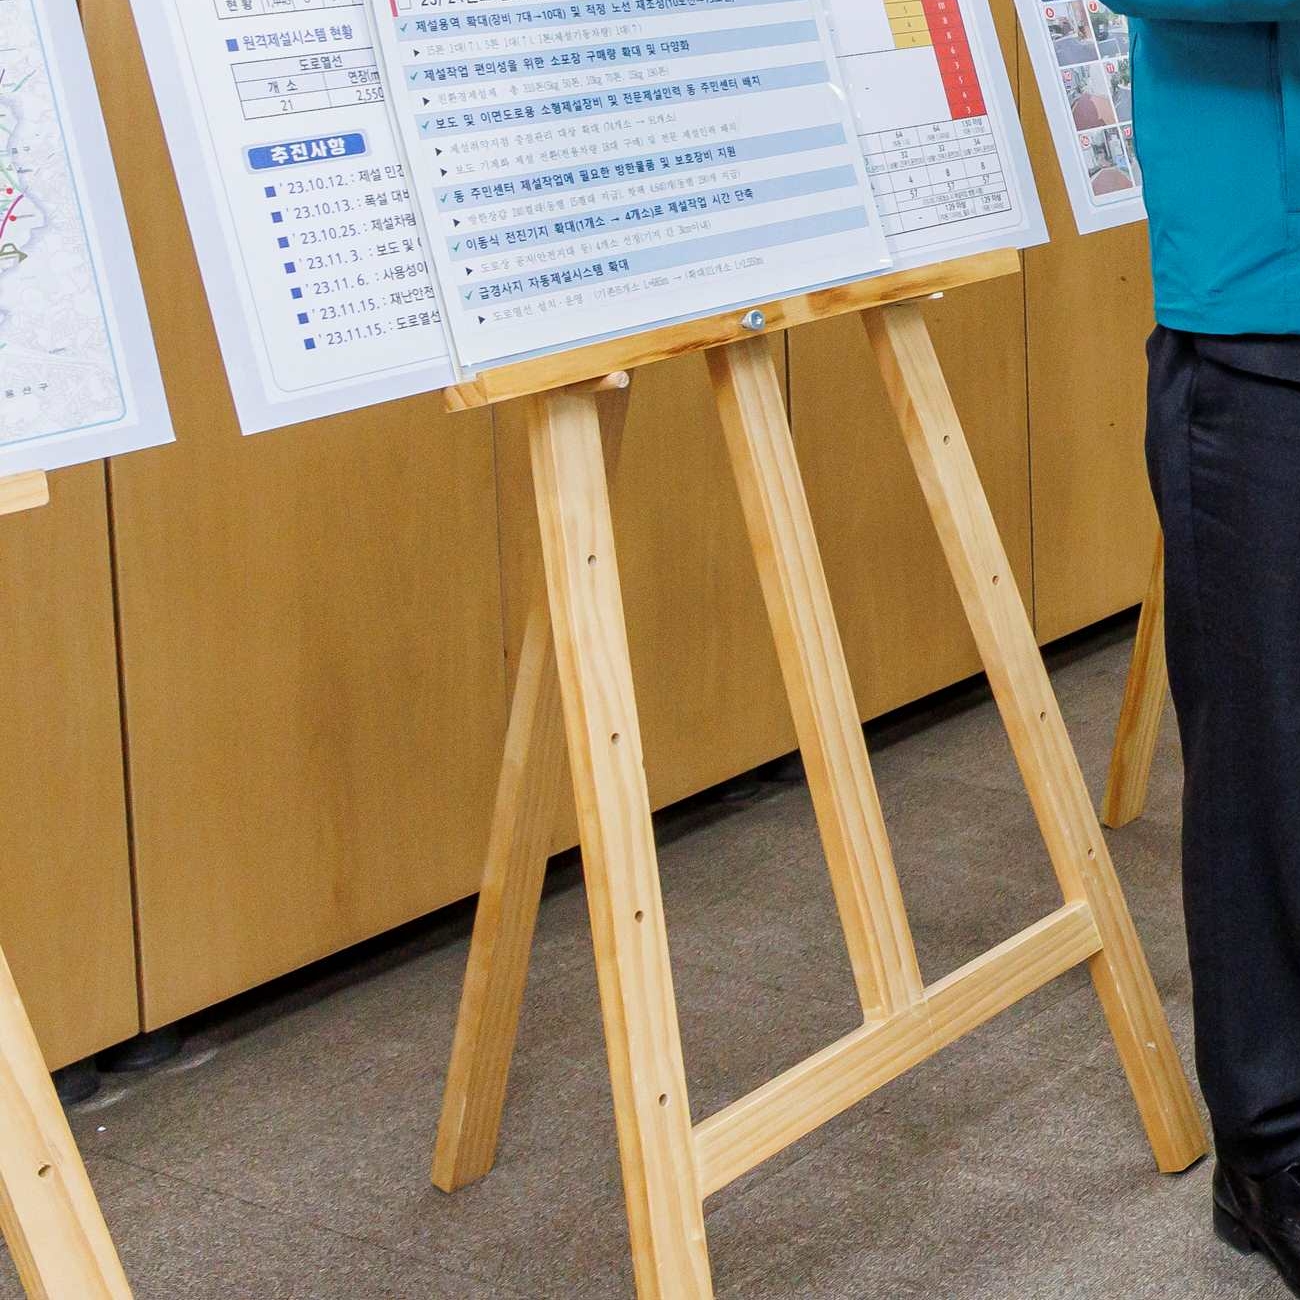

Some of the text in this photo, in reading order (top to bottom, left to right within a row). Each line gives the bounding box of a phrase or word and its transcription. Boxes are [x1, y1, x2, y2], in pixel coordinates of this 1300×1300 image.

[415, 16, 462, 33] 제설용역
[466, 10, 512, 28] 확대(장비
[570, 6, 581, 18] 및
[586, 3, 607, 17] 적정
[611, 1, 632, 14] 노선
[242, 23, 353, 51] 원격제설시스템 현황
[299, 54, 344, 71] 도로열선
[423, 64, 469, 83] 제설작업
[473, 59, 518, 77] 편의성을
[523, 56, 546, 71] 위한
[550, 52, 581, 67] 소포장
[586, 47, 617, 63] 구매량
[621, 45, 642, 59] 확대
[645, 43, 657, 56] 및
[660, 39, 690, 53] 다양화
[435, 74, 762, 130] 보도 및 이면도로용 소형제설장비 및 전문제설인력 동 주민센터 배치
[270, 137, 347, 165] 추진사항
[358, 167, 383, 183] 제설
[453, 144, 737, 204] 동 주민센터 제설작업에 필요한 방한물품 및 보호장비 지원
[364, 192, 388, 207] 폭설
[465, 234, 500, 251] 이동식
[505, 226, 550, 246] 전진기지
[624, 204, 665, 223] 4개소)로
[668, 196, 708, 214] 제설작업
[712, 192, 732, 206] 시간
[734, 187, 755, 202] 단축
[376, 237, 414, 257] 보도 및
[477, 257, 631, 301] 급경사지 자동제설시스템 확대
[390, 285, 435, 305] 재난안전
[392, 310, 442, 330] 도로열선
